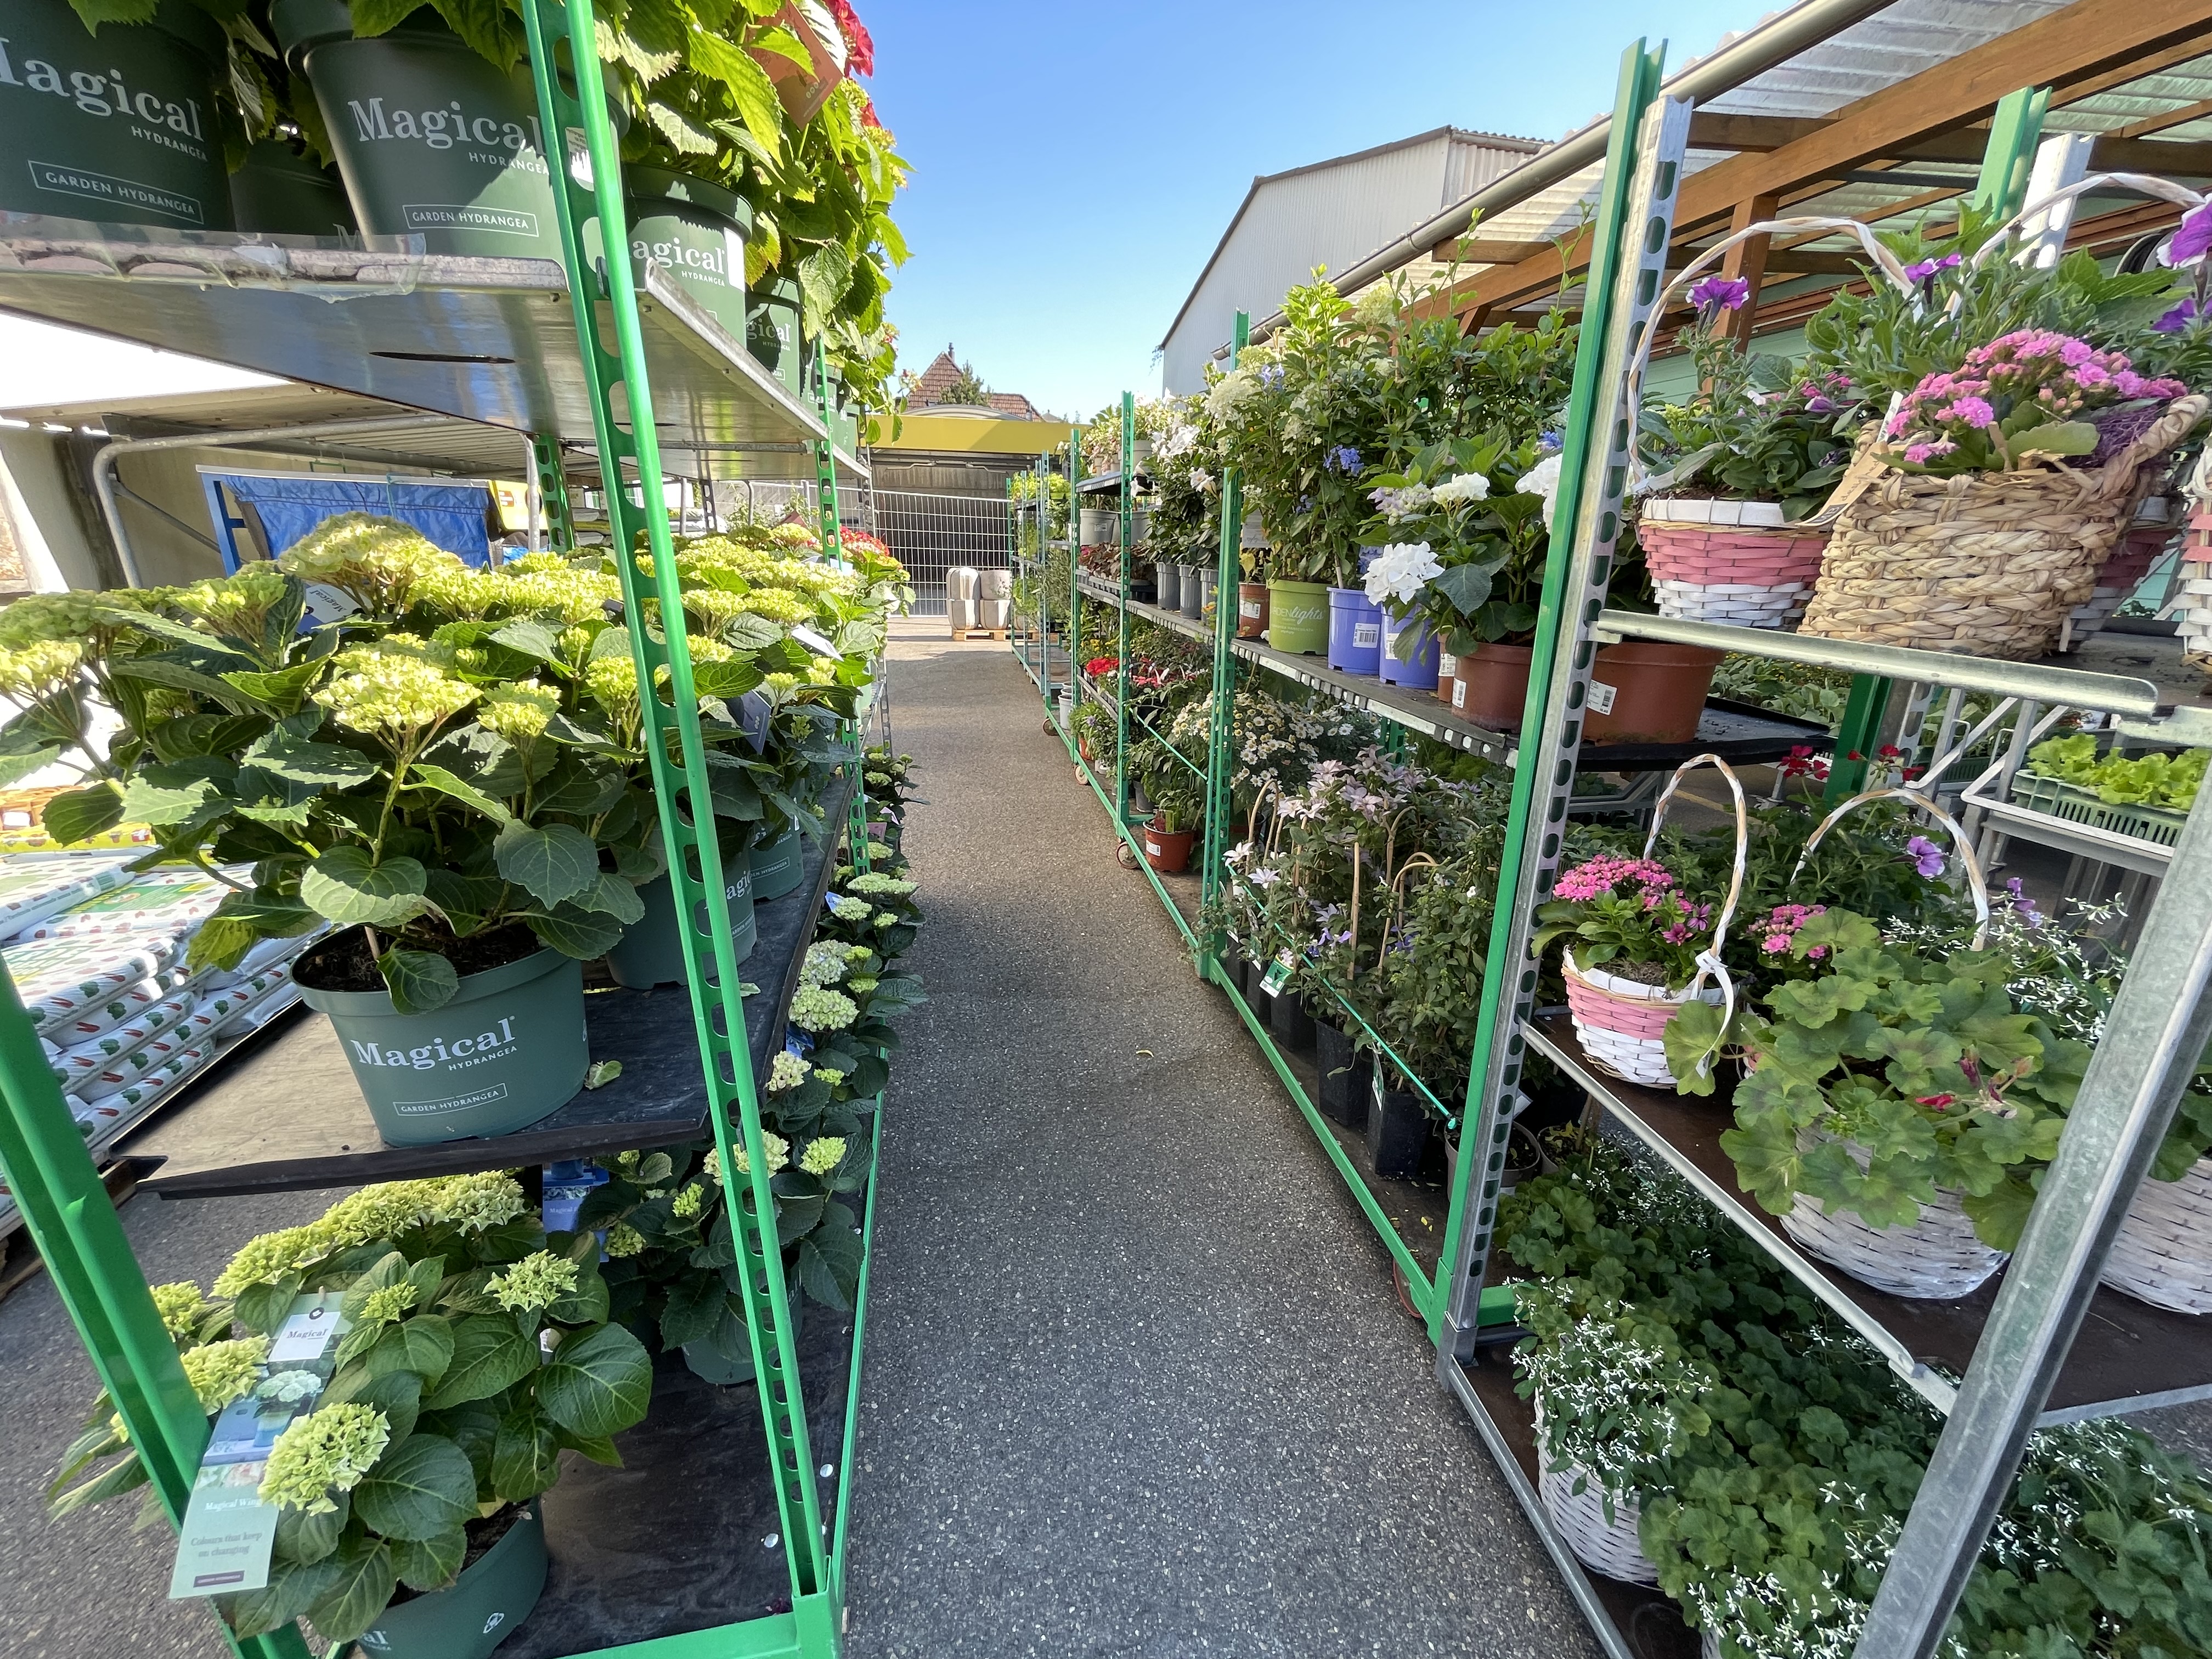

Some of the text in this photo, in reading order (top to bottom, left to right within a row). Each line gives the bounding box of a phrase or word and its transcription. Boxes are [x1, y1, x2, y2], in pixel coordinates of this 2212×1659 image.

[348, 97, 547, 156] Magical
[131, 126, 207, 161] HYDRANGEA
[469, 152, 549, 175] HYDRANGEA
[46, 172, 195, 215] GARDEN HYDRANGEA
[412, 211, 529, 229] GARDEN HYDRANGEA
[633, 237, 725, 274] agical
[681, 270, 725, 287] HYDRANGEA
[746, 318, 791, 342] gical
[309, 590, 347, 612] Magical
[777, 833, 792, 844] RANGEA
[761, 861, 787, 874] HYDRANGEA
[732, 925, 744, 935] ARDEN
[351, 1016, 516, 1070] Magical
[449, 1046, 518, 1071] HYDRANGEA
[401, 1090, 500, 1113] GARDEN HYDRANGEA
[286, 1328, 329, 1339] Magical
[205, 1498, 262, 1511] Magical Wing
[191, 1532, 262, 1546] Colours that keep
[211, 1545, 250, 1556] changing
